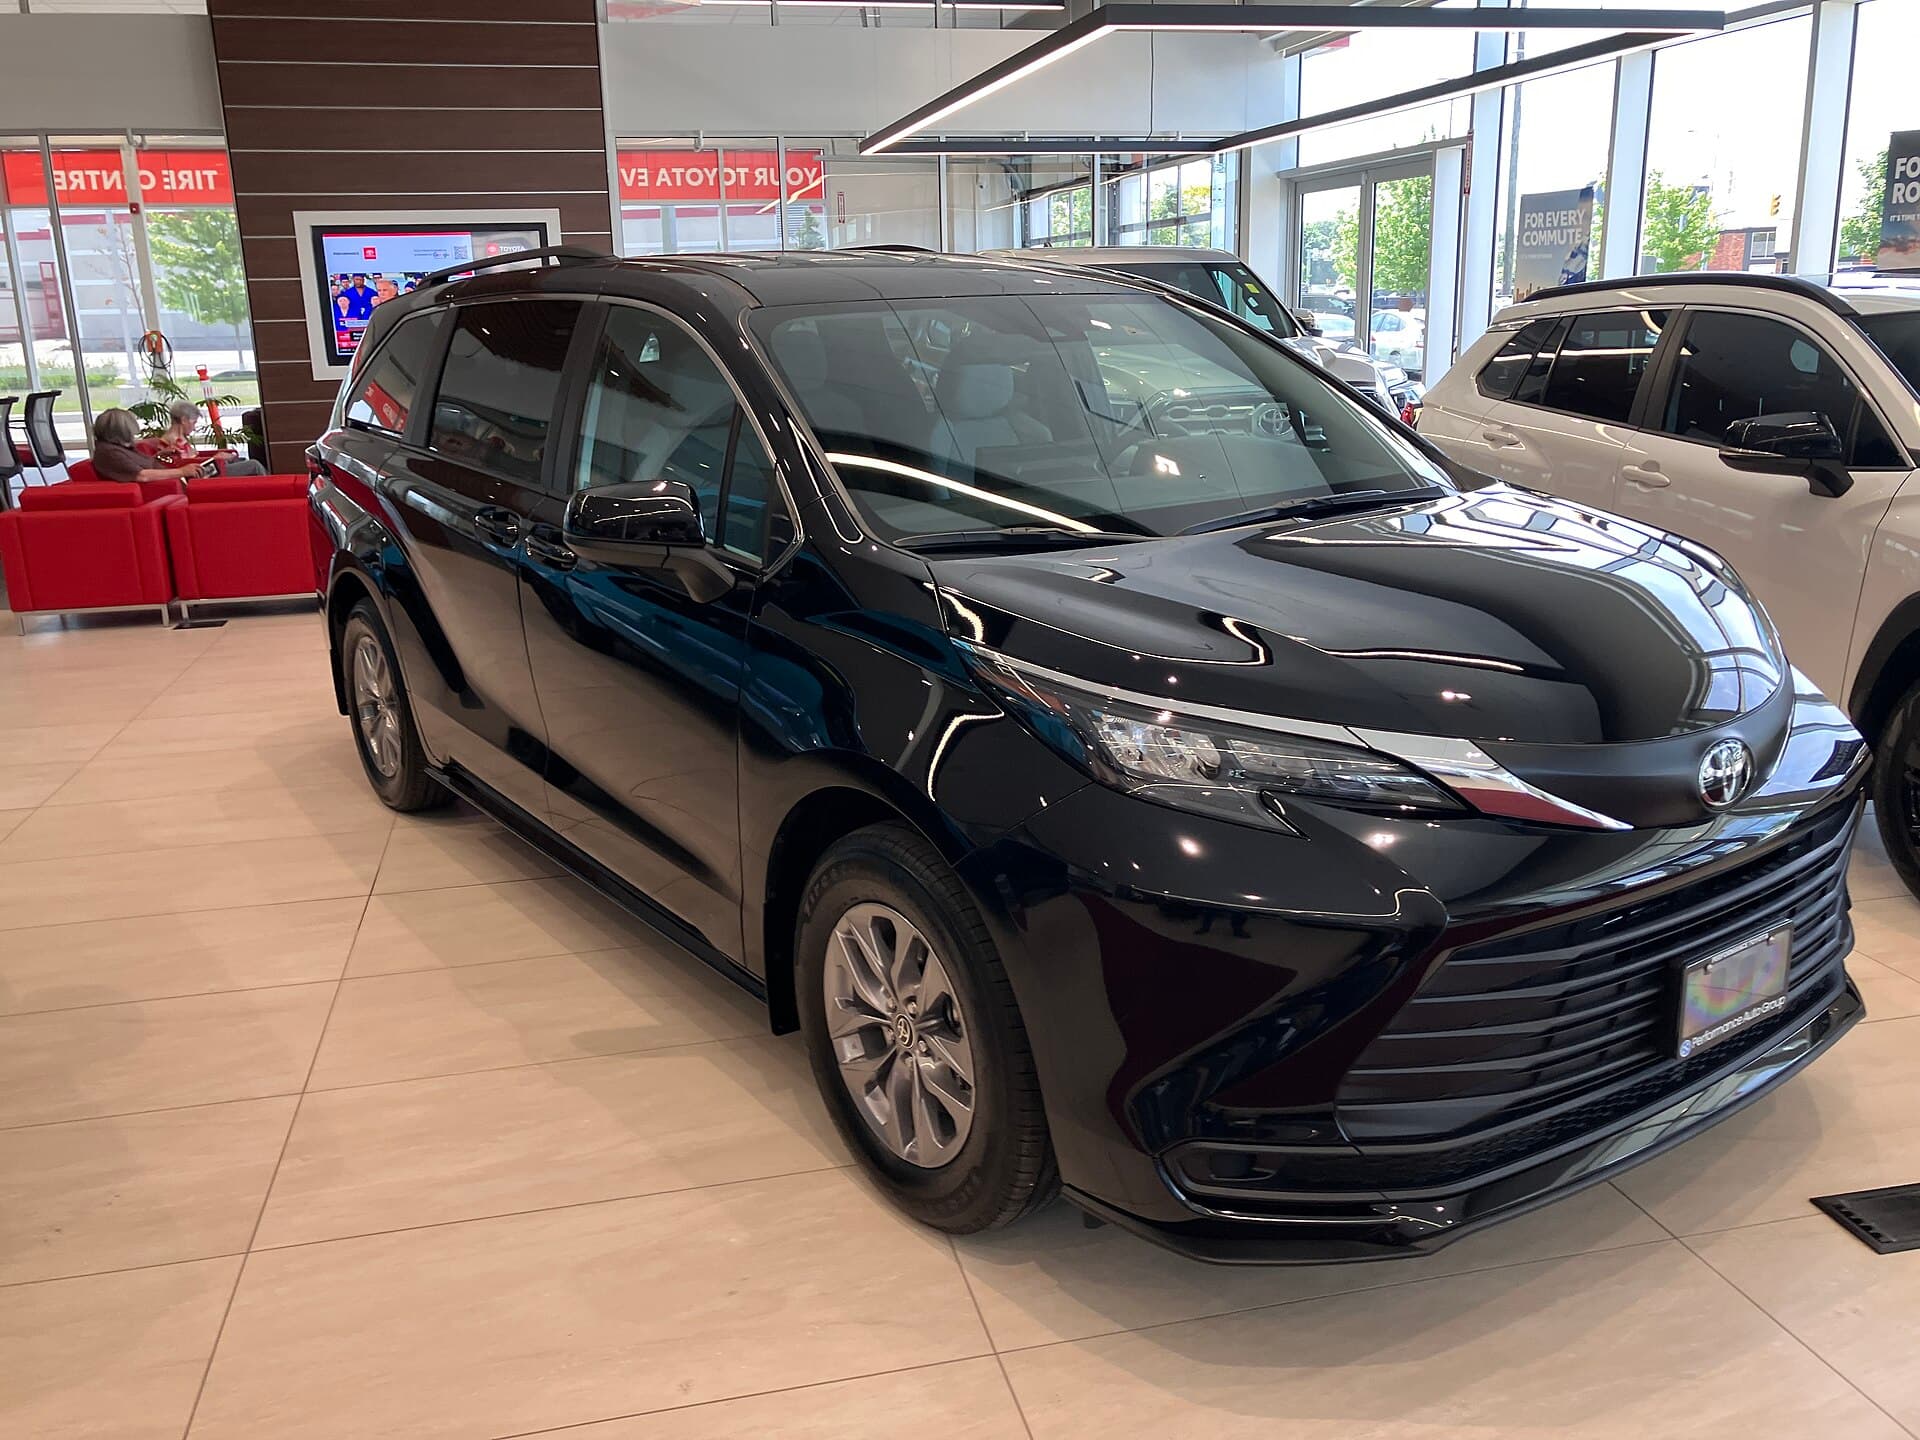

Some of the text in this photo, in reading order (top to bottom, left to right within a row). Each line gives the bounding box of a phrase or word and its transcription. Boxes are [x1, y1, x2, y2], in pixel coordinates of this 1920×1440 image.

[1524, 209, 1586, 229] FOR EVERY
[1522, 228, 1582, 247] COMMUTE
[1692, 996, 1786, 1048] Performance Auto Group
